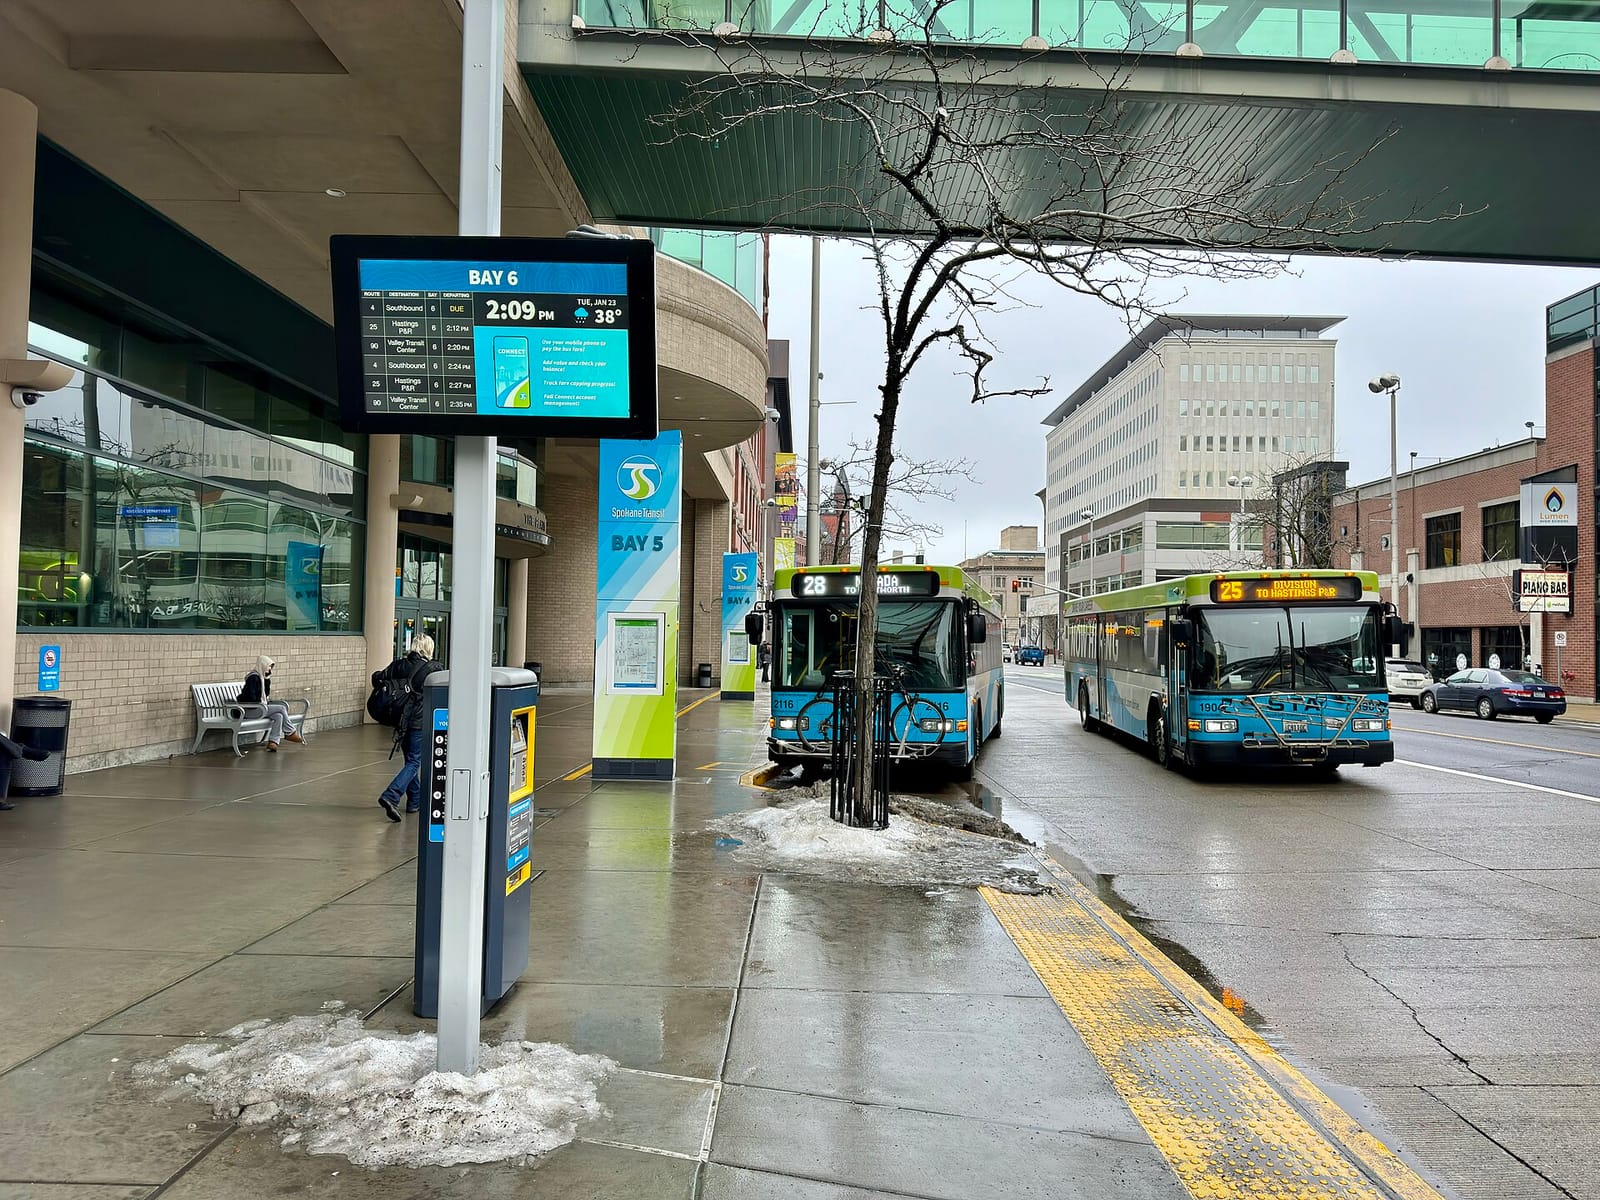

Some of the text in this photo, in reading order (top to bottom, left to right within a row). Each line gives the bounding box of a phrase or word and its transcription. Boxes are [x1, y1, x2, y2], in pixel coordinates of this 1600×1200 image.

[468, 270, 519, 286] BAY 6
[577, 299, 593, 307] TUE,
[486, 300, 554, 320] 2:09 PM
[594, 309, 622, 324] 38°
[392, 320, 419, 328] Hastings
[394, 377, 421, 385] Hastings
[611, 507, 665, 520] Spokane Transit
[612, 535, 664, 551] BAY 5
[804, 575, 898, 595] 28 NADA
[1221, 580, 1317, 600] 25 DIVISION
[1523, 581, 1567, 594] PIANO BAR
[1256, 588, 1336, 598] TO HASTINGS P&R
[745, 597, 750, 605] 4
[774, 700, 794, 709] 2116
[1268, 697, 1321, 712] STA
